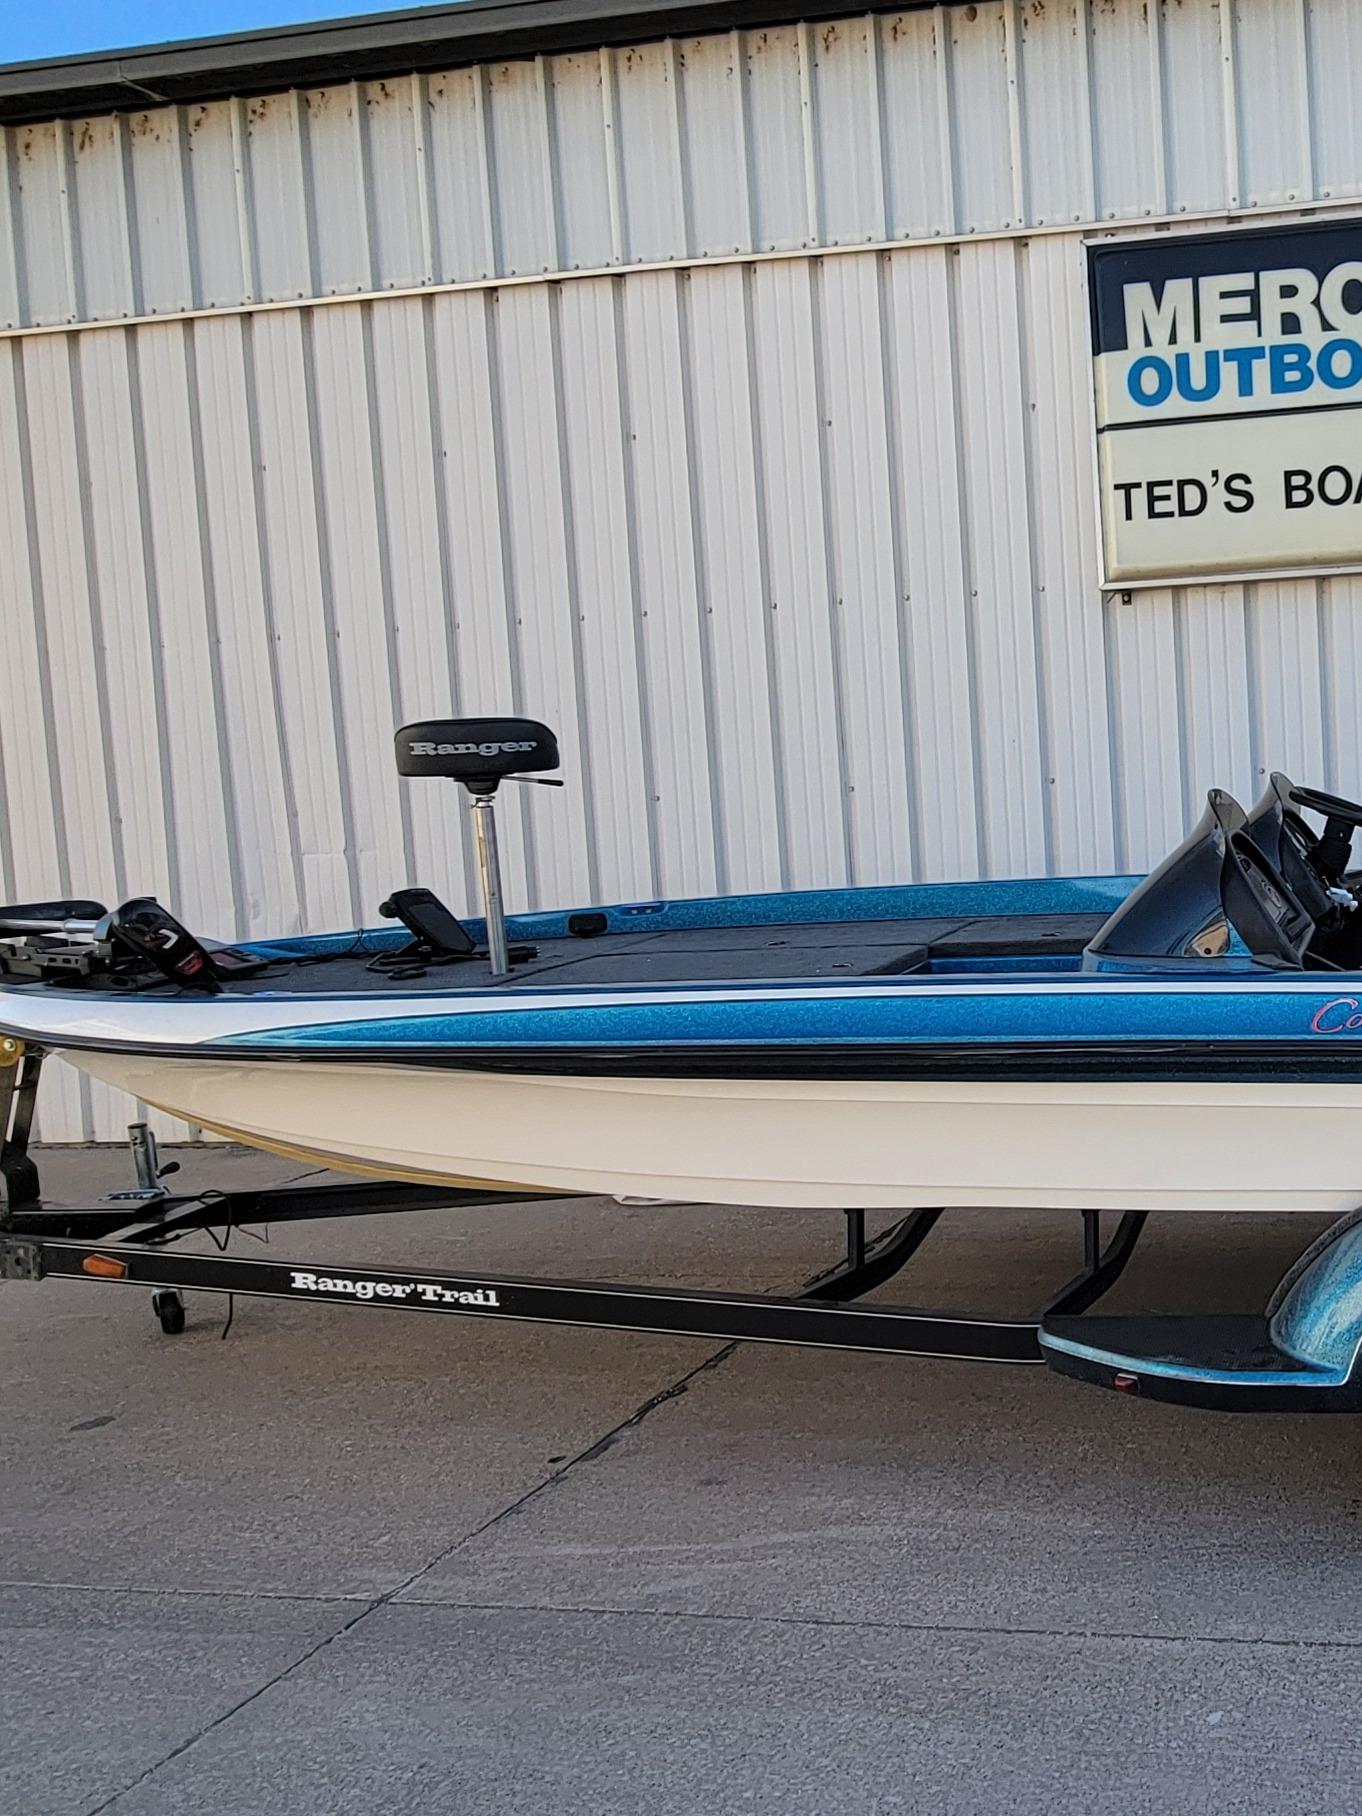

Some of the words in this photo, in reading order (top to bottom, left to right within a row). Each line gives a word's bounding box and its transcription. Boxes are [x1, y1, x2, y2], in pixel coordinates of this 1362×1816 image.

[1114, 470, 1255, 522] TED'S
[408, 741, 538, 757] Ranger
[416, 1284, 500, 1307] Trail
